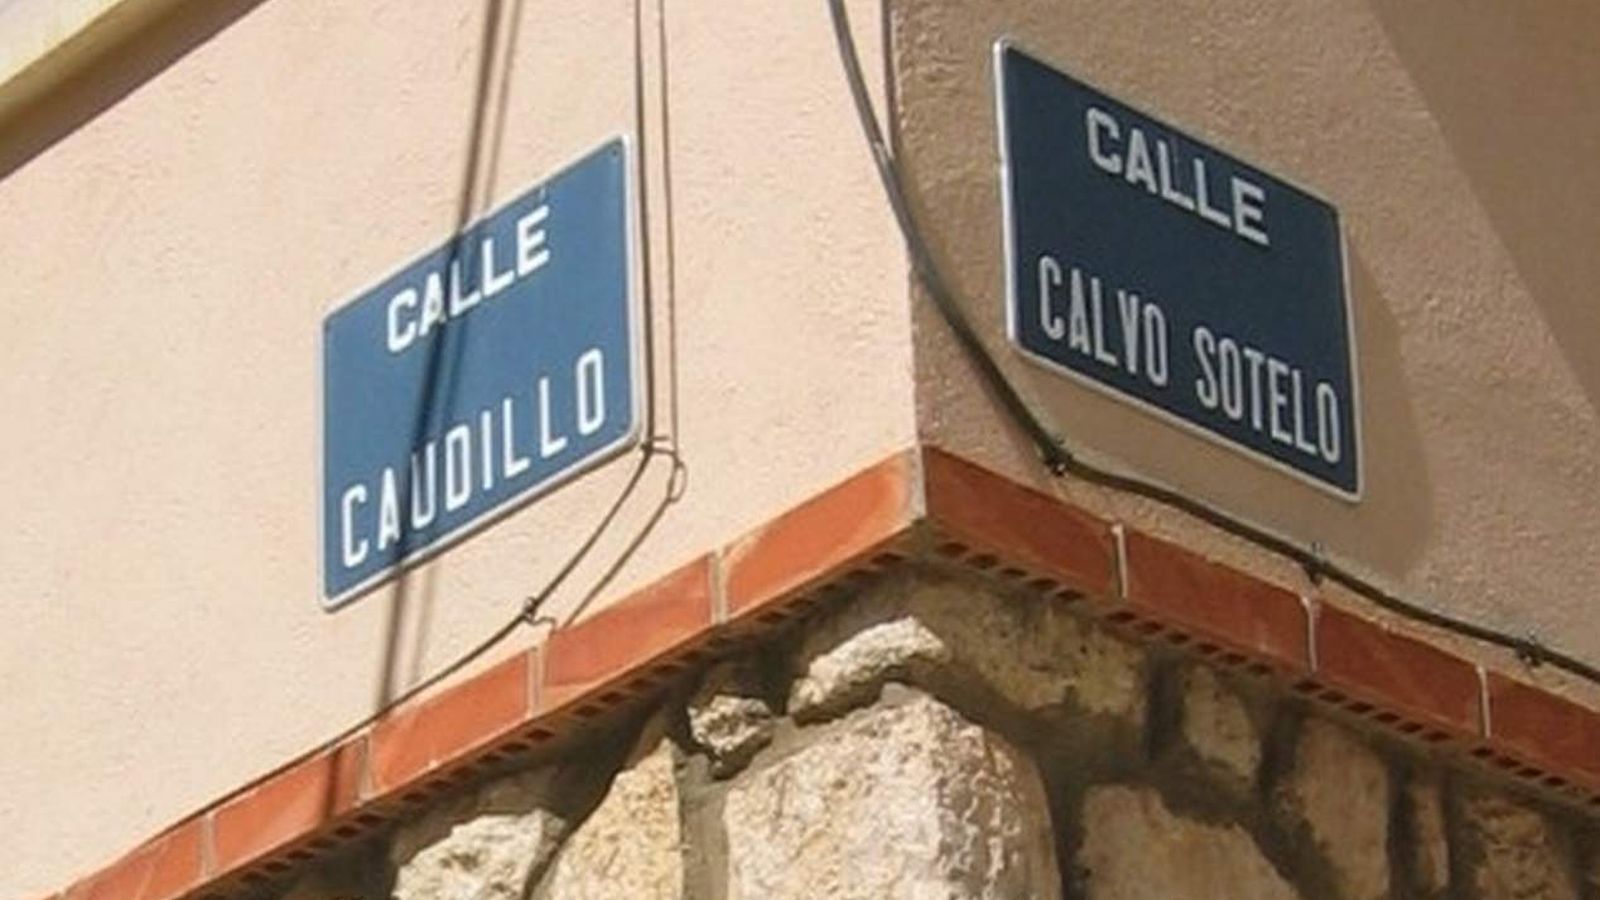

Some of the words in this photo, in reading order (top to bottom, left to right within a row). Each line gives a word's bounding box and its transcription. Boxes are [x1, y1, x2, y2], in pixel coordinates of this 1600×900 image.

[1086, 107, 1269, 247] CALLE
[386, 205, 550, 352] CALLE
[1039, 255, 1168, 387] CALVO
[1193, 326, 1340, 464] SOTELO
[341, 348, 605, 567] CAUDILLO
